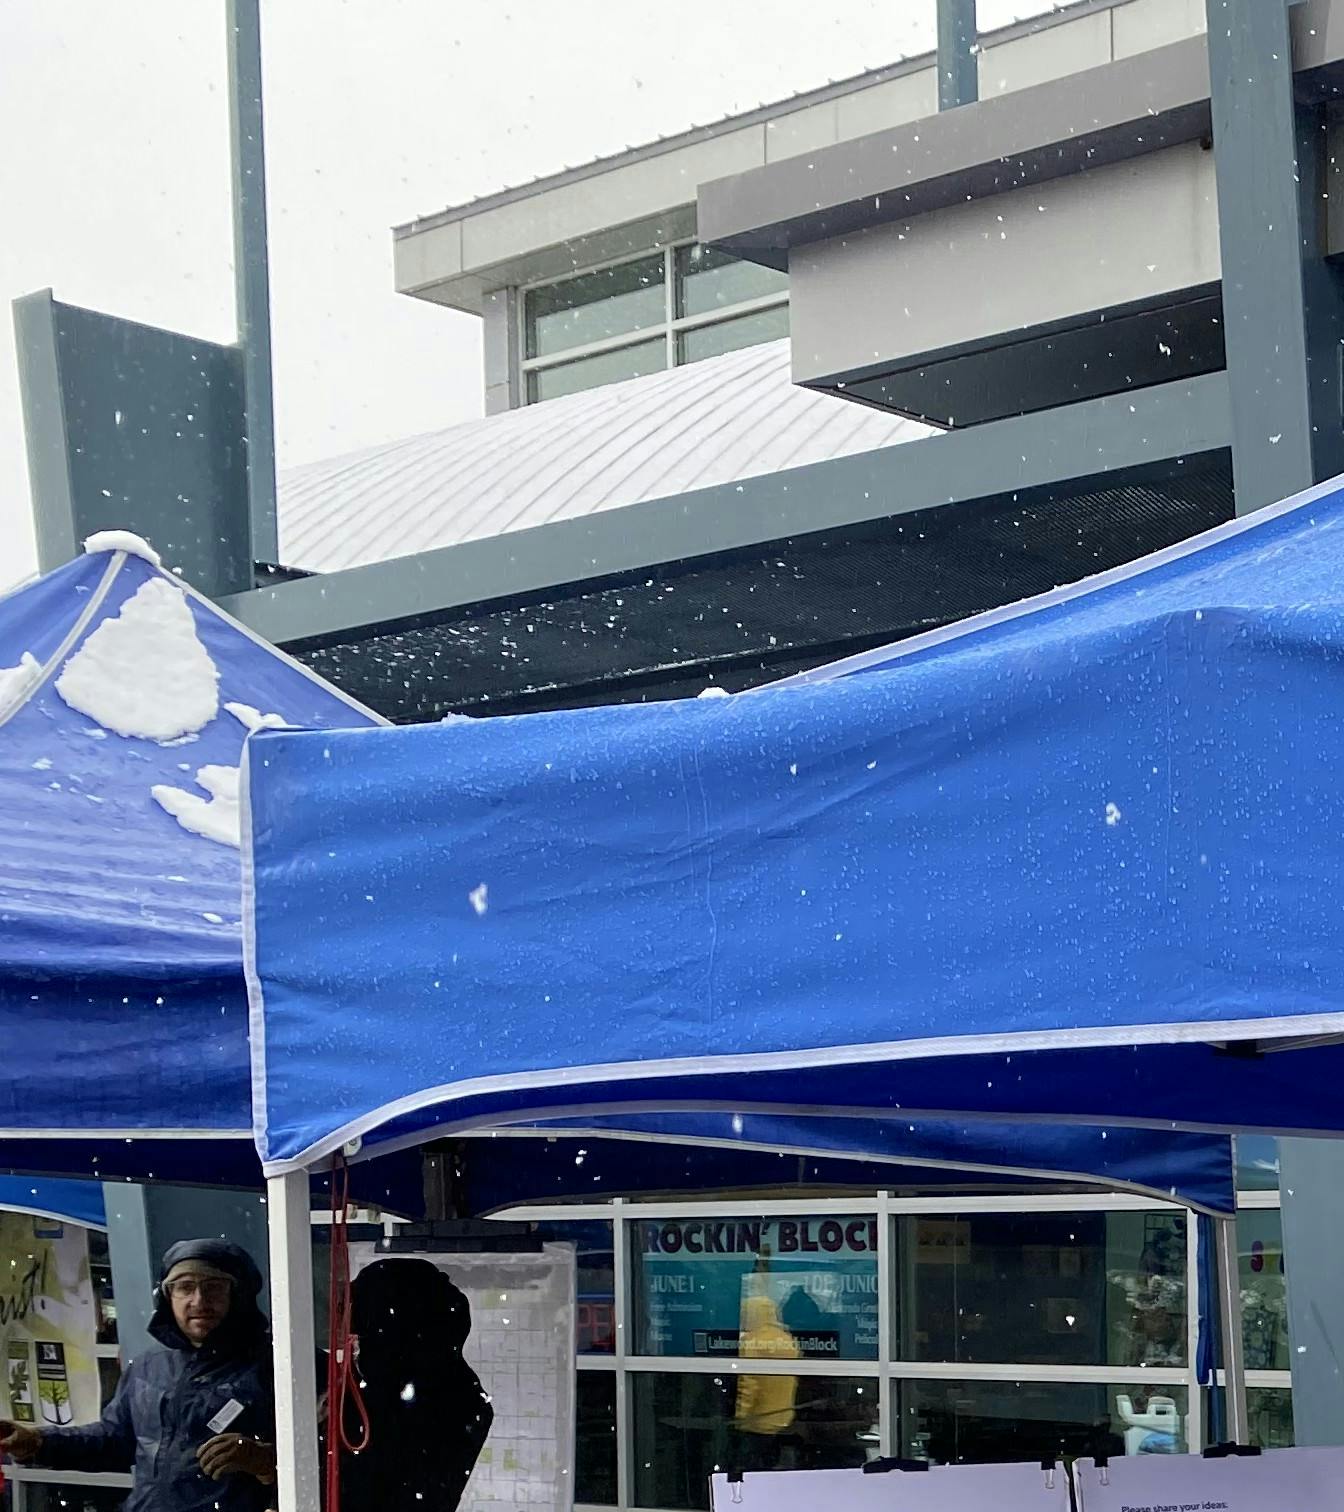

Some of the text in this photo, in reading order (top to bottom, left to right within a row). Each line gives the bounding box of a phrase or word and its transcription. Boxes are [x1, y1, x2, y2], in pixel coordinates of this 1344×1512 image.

[650, 1275, 686, 1293] JUNE
[1153, 1504, 1178, 1512] share
[1179, 1502, 1200, 1512] your
